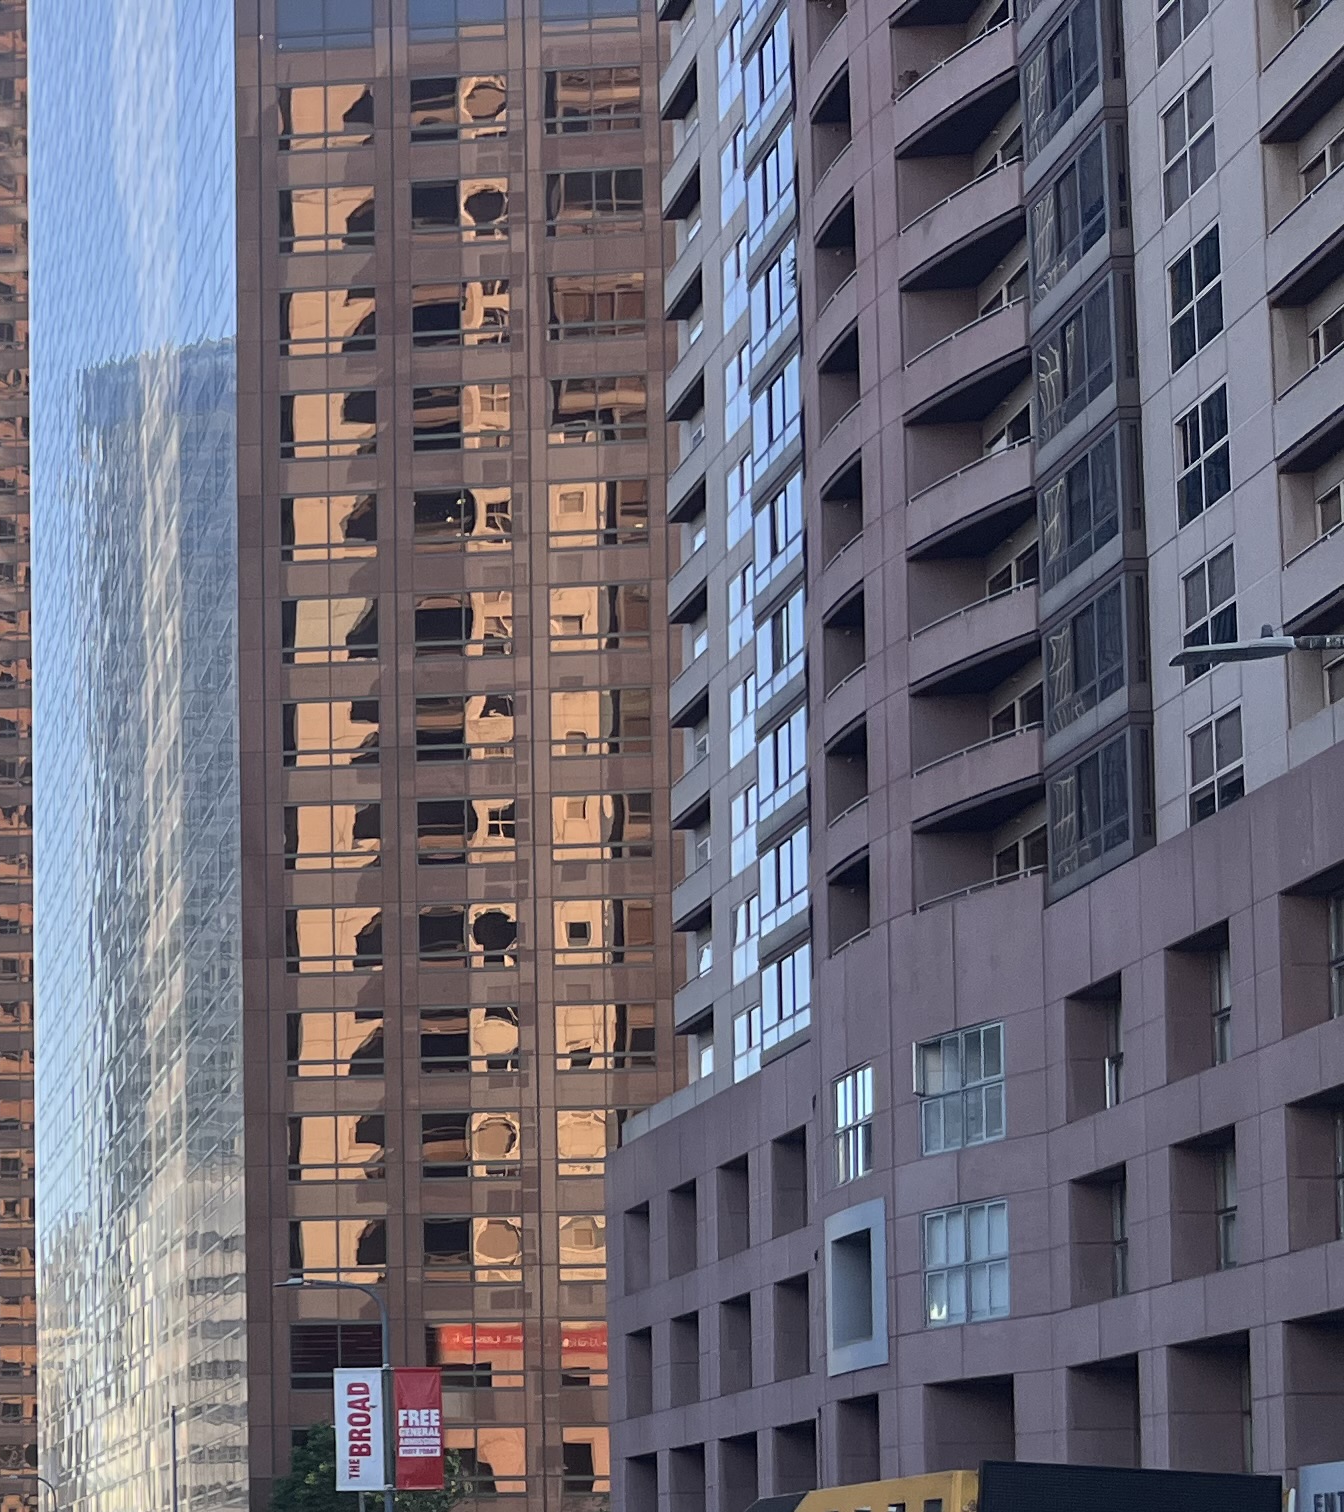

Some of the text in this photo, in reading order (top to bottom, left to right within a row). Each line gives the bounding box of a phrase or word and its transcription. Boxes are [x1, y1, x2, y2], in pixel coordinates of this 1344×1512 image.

[398, 1409, 440, 1426] FREE
[347, 1382, 372, 1479] THE BROAD
[399, 1428, 440, 1437] GENERAL
